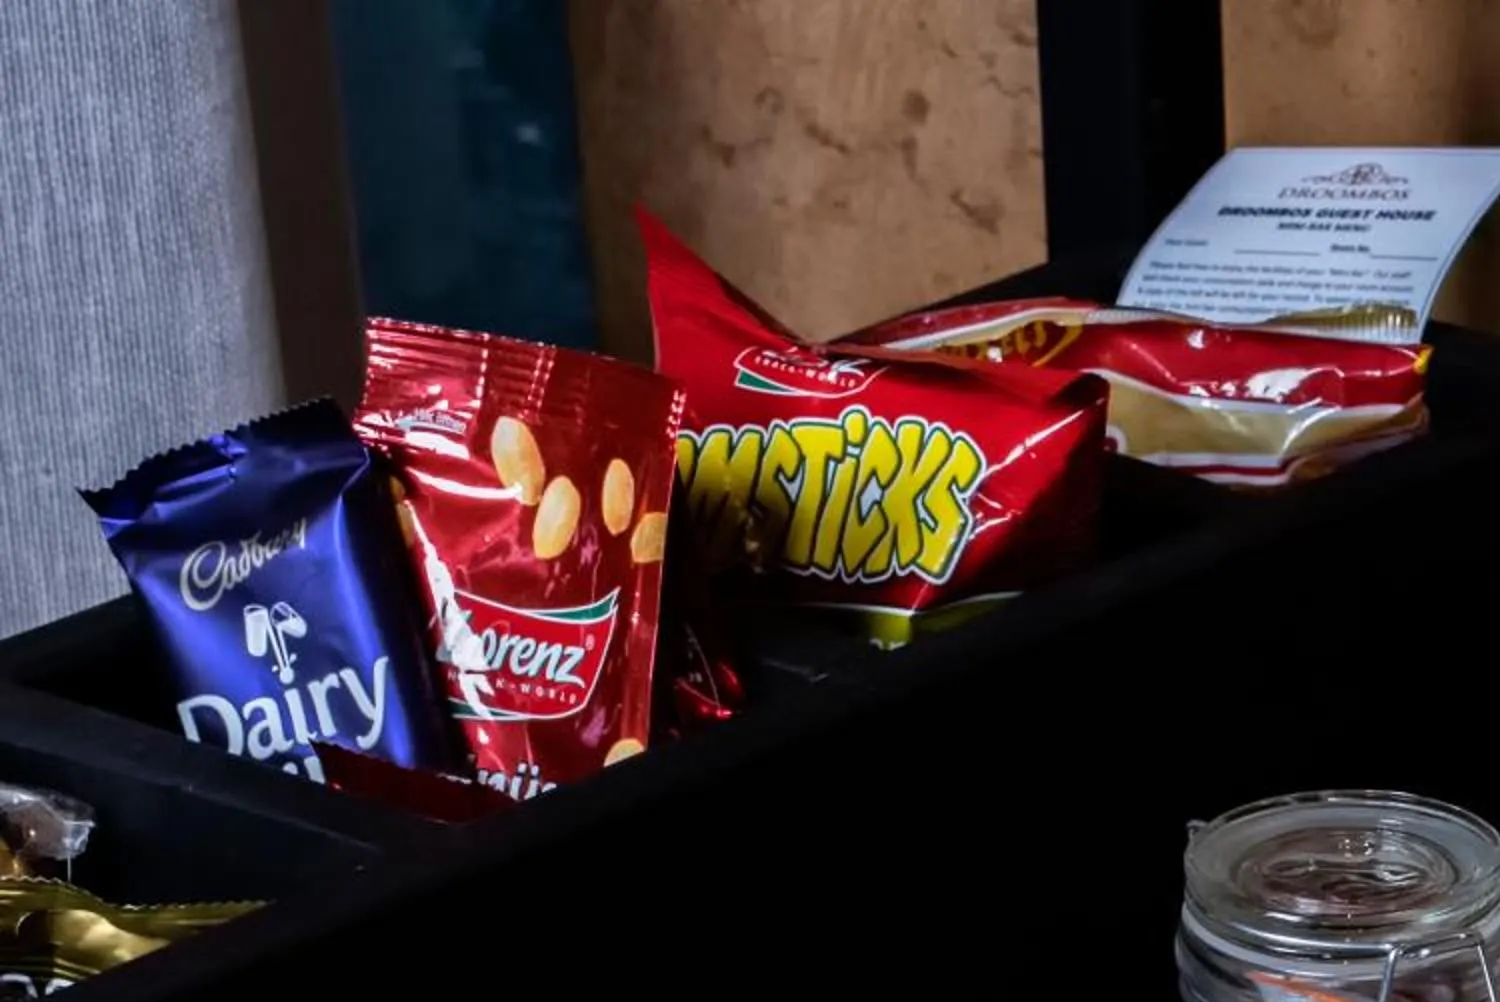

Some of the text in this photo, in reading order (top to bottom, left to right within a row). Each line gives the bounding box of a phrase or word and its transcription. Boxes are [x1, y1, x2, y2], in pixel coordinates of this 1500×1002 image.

[1316, 208, 1372, 219] GUEST
[1375, 210, 1436, 221] HOUSE
[179, 518, 307, 611] Cadbury
[436, 602, 586, 689] orenz
[176, 655, 389, 761] Dairy
